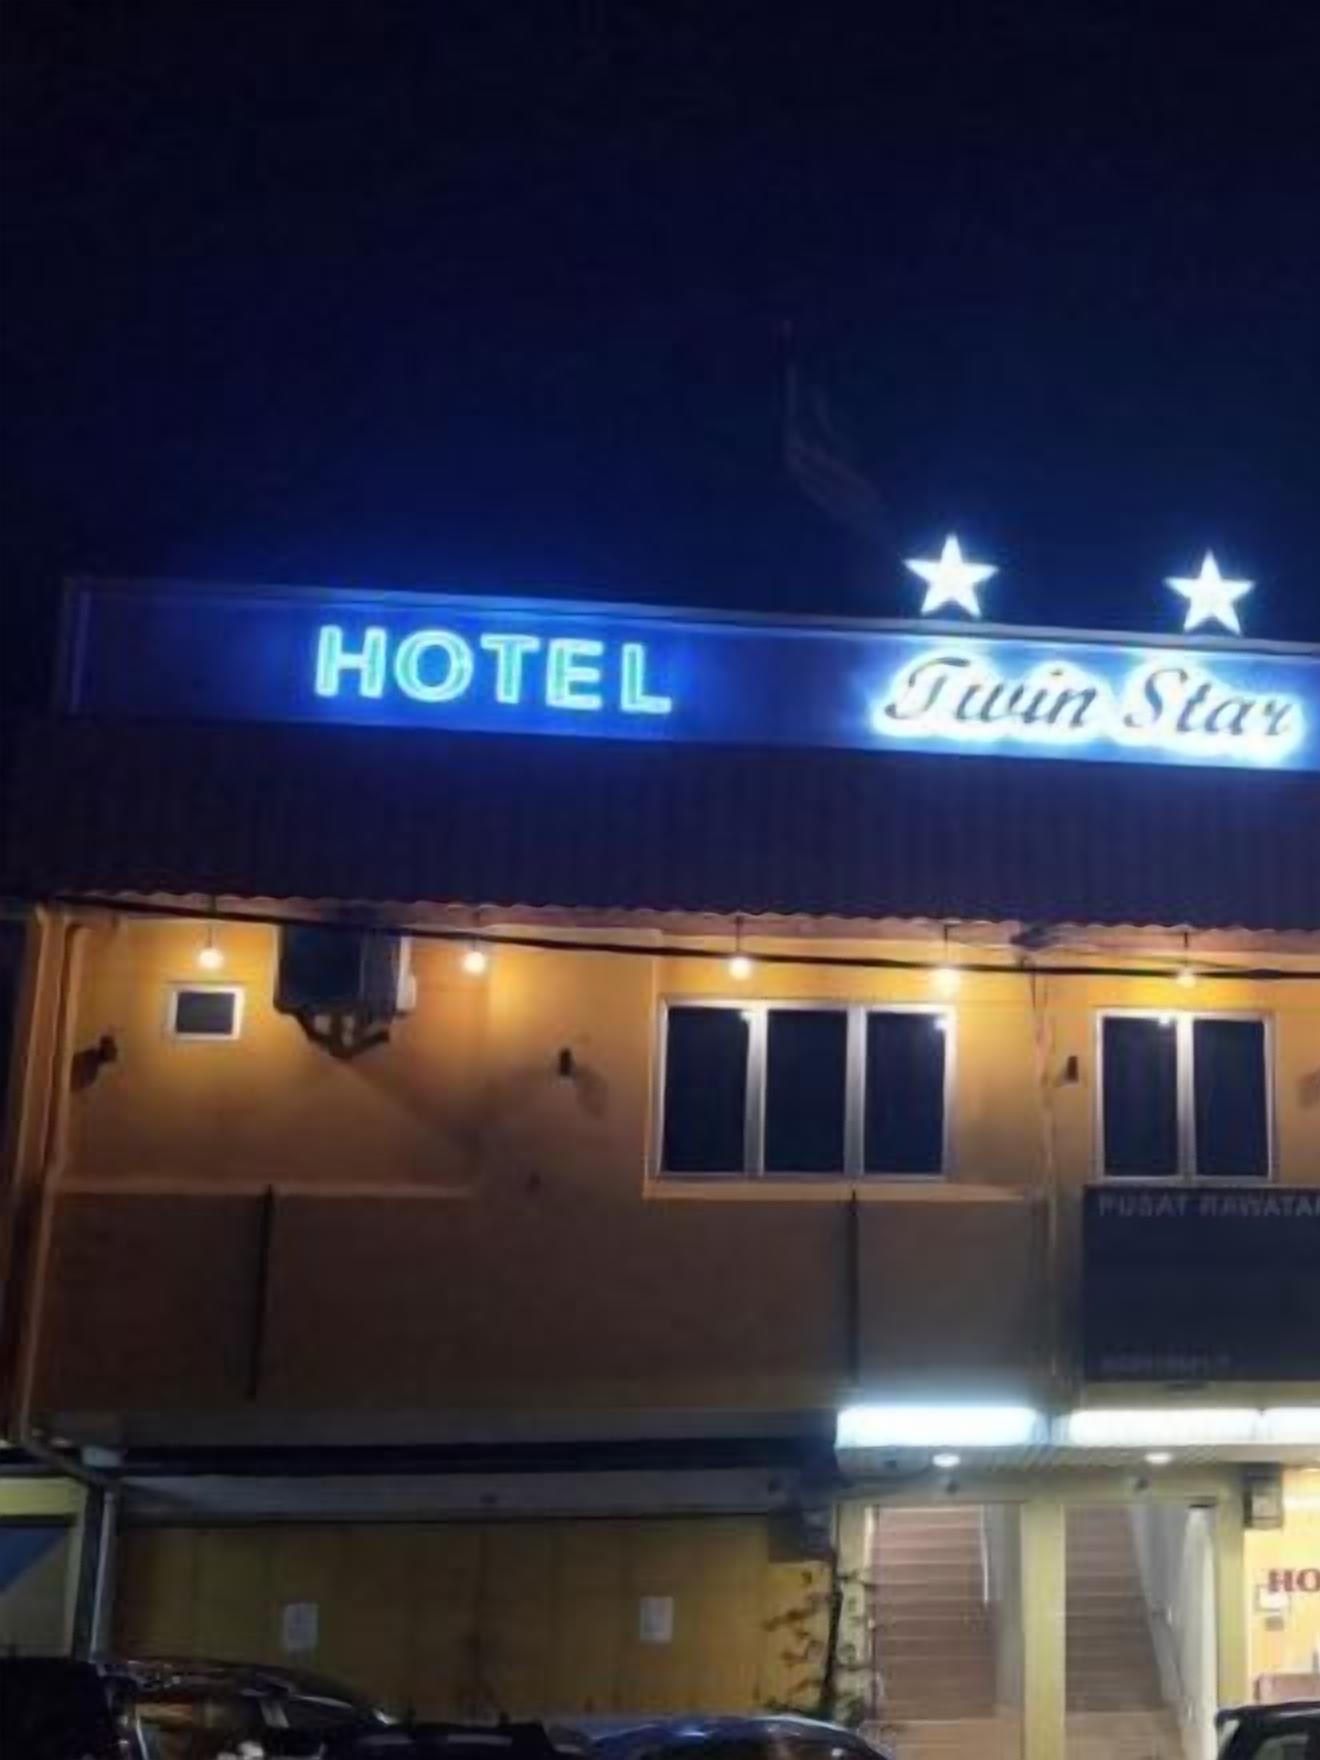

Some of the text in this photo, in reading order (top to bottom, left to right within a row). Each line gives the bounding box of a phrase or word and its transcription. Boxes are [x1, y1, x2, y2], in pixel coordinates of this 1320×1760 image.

[315, 624, 673, 714] HOTEL
[884, 655, 1294, 737] Twin Star
[1098, 1194, 1189, 1217] PUSAT
